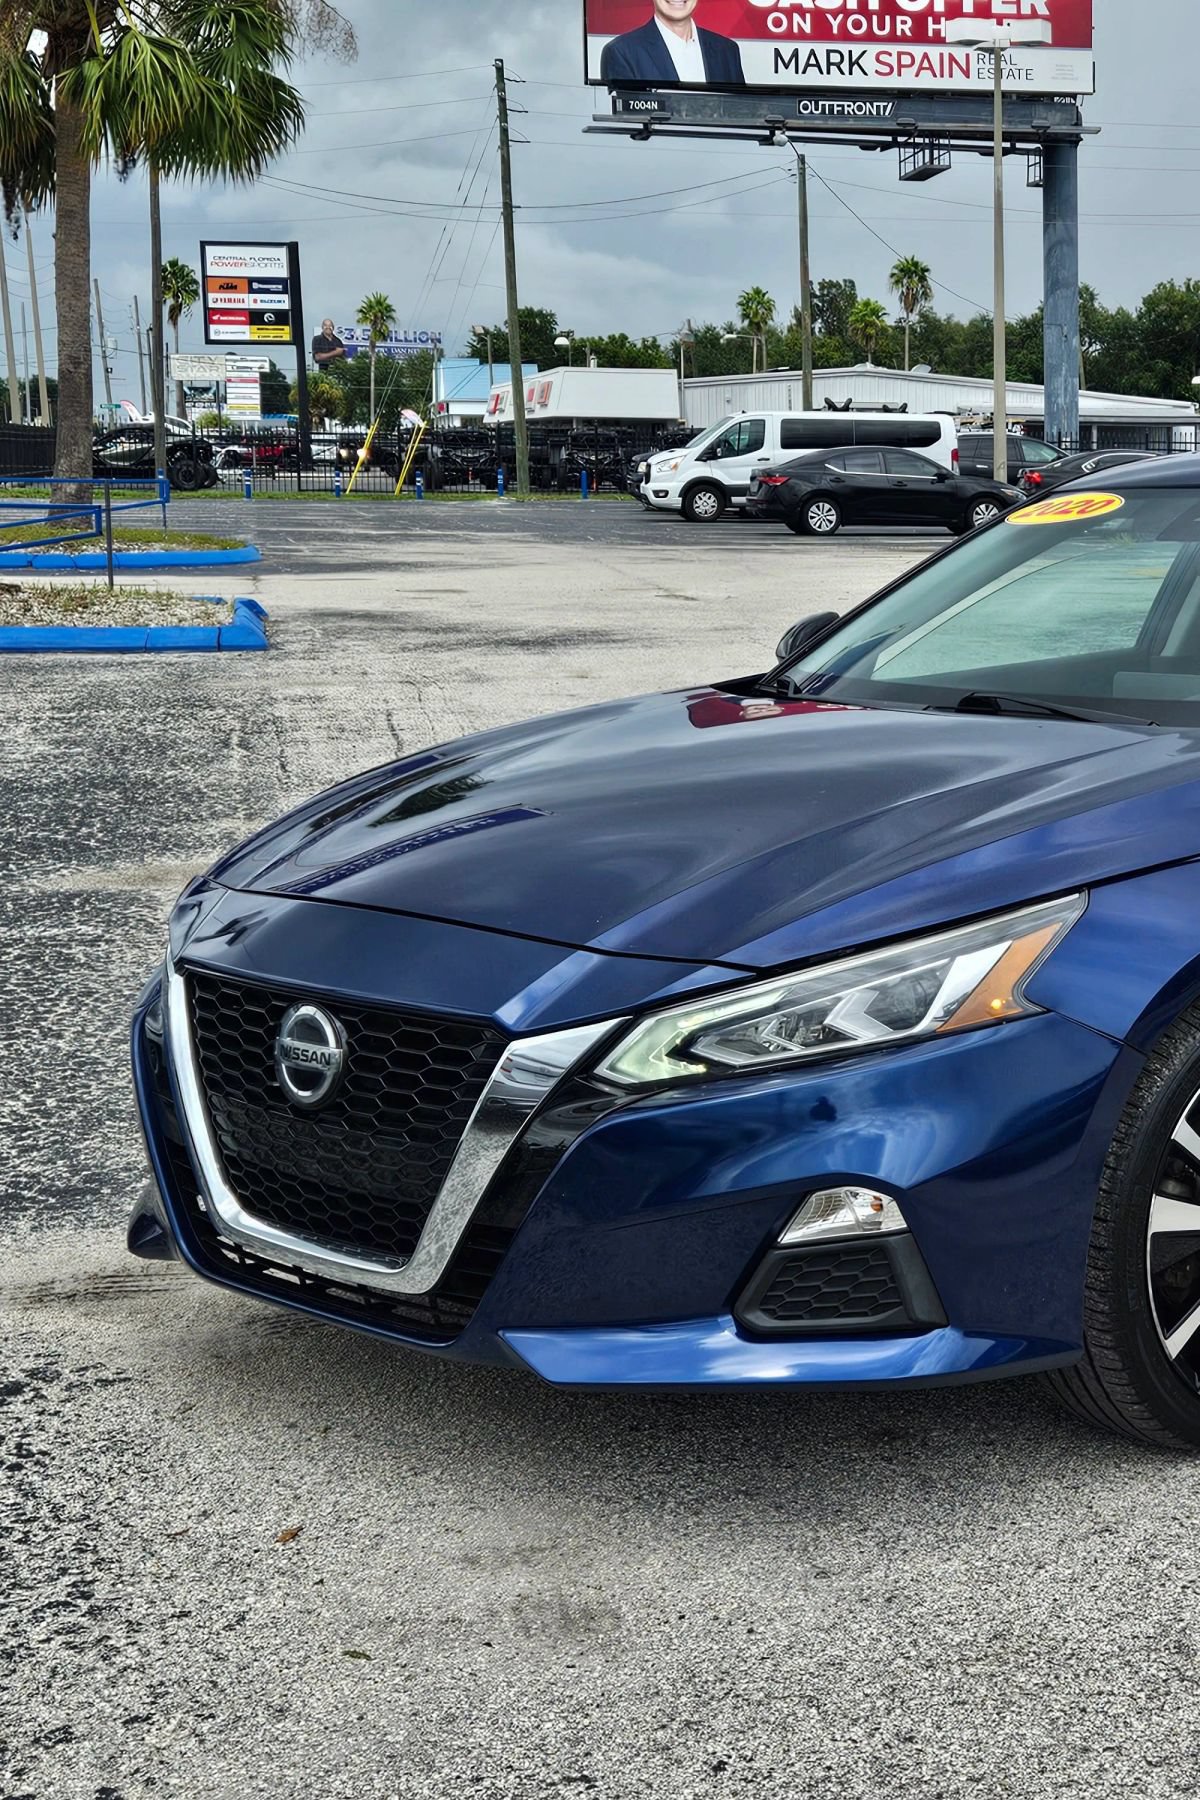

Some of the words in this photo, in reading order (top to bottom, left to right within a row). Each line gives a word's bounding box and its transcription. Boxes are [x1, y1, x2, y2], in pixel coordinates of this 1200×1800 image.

[766, 11, 812, 34] ON
[825, 13, 913, 37] YOUR
[773, 47, 869, 77] MARK
[874, 50, 971, 79] SPAIN
[976, 52, 1018, 66] REAL
[977, 67, 1035, 81] ESTATE
[628, 100, 658, 111] 7004N
[210, 260, 284, 269] POWERSPORTS
[218, 282, 238, 290] KTM
[1013, 499, 1116, 519] 2020
[280, 1043, 332, 1067] NISSAN
